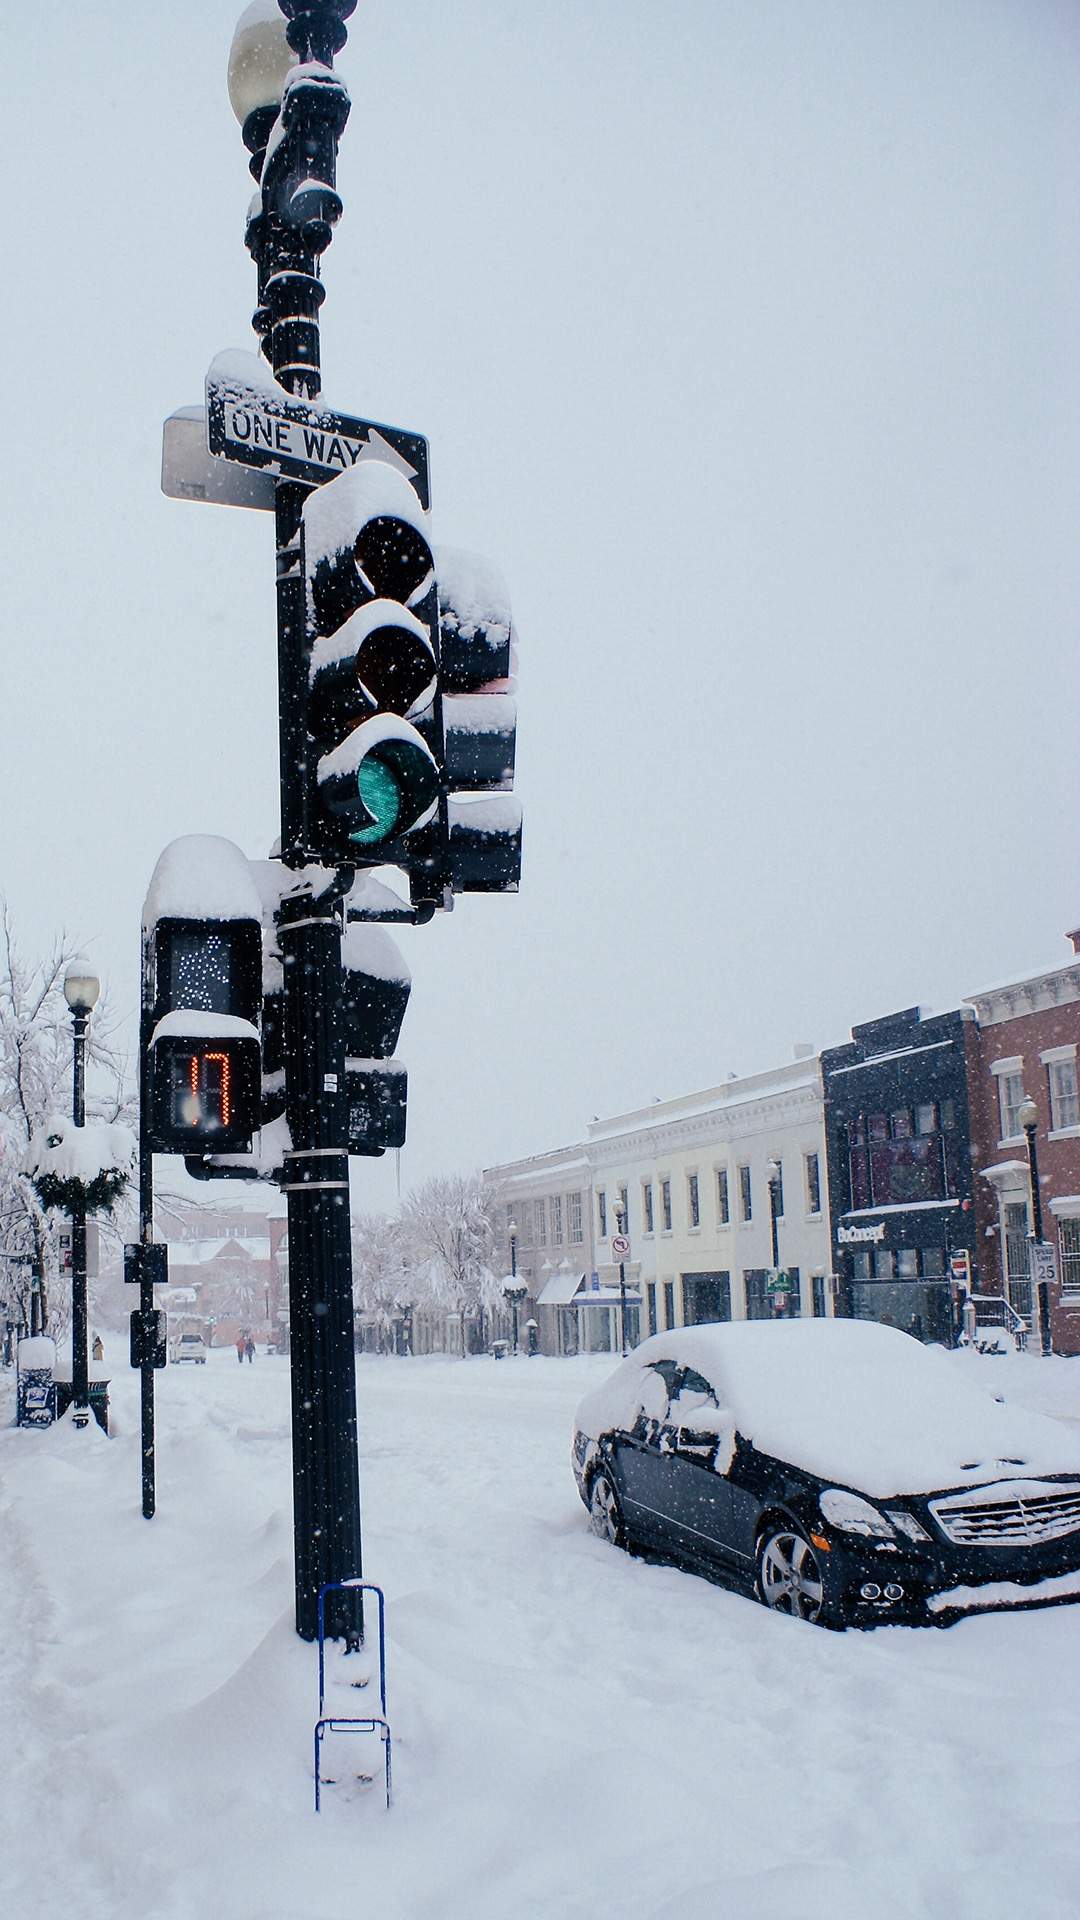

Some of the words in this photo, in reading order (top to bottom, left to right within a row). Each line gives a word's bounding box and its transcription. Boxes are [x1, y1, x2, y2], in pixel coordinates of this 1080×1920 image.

[232, 412, 292, 453] ONE
[303, 429, 364, 469] WAY
[191, 1053, 230, 1127] 17
[1038, 1265, 1056, 1279] 25
